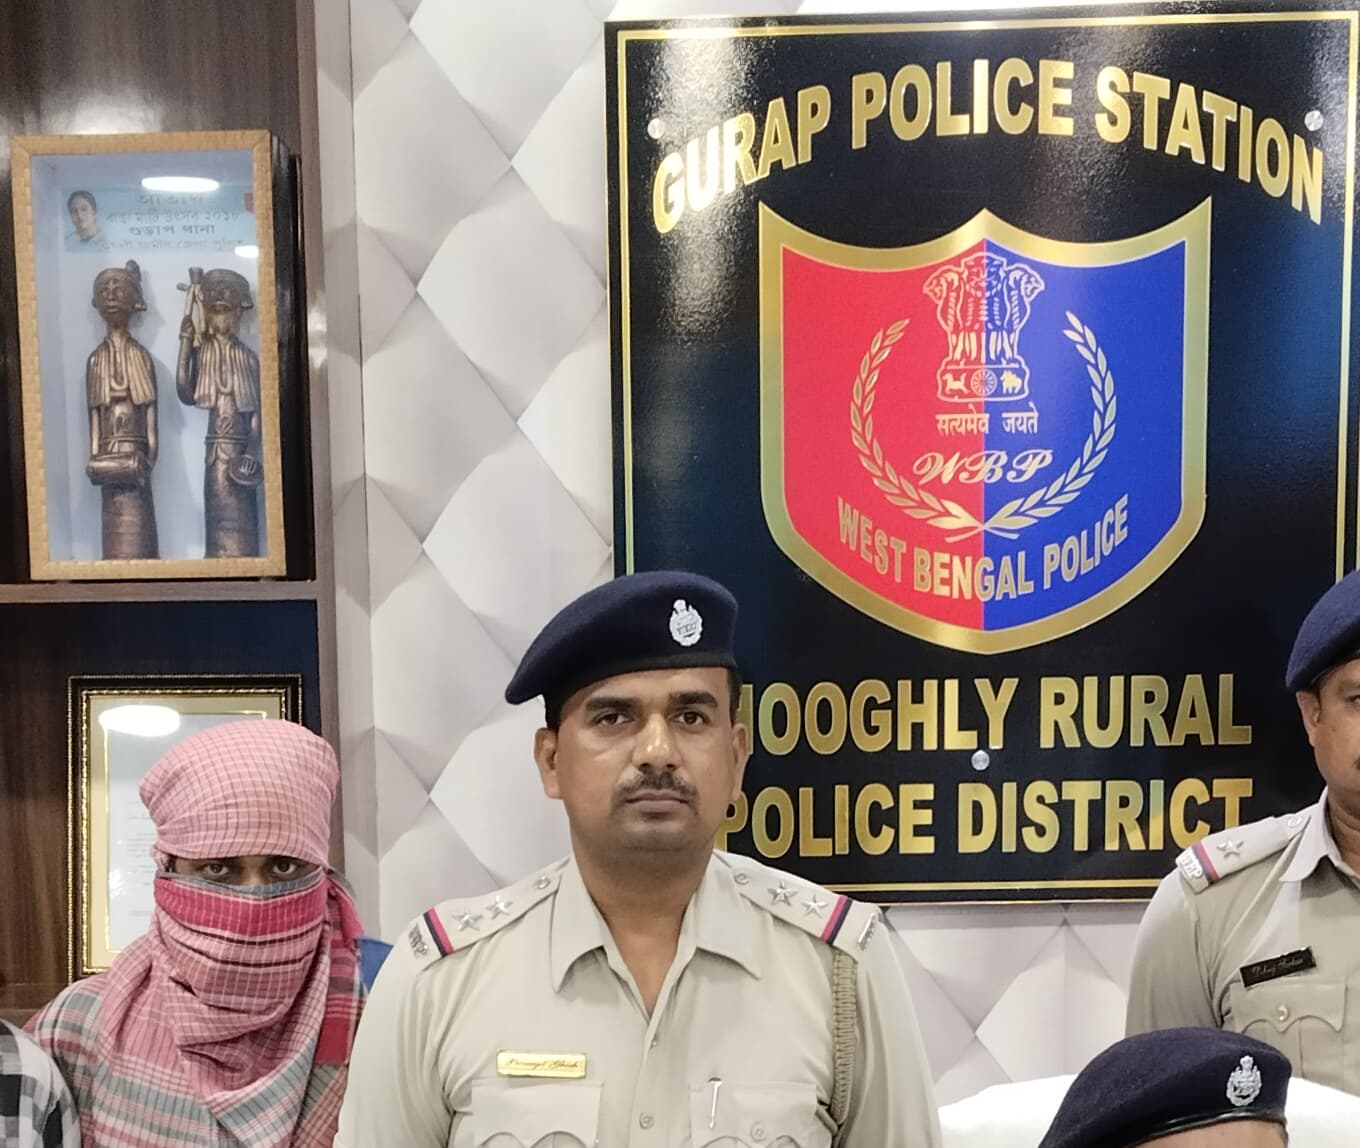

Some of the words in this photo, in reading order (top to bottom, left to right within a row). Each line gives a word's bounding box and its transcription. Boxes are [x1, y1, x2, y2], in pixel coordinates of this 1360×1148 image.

[652, 85, 832, 234] GURAP
[851, 58, 1075, 149] POLICE
[1094, 65, 1324, 226] STATION
[935, 402, 991, 436] सत्यमेव
[1001, 401, 1040, 435] जयते
[837, 495, 907, 584] WEST
[913, 546, 1035, 603] BENGAL
[1042, 493, 1130, 591] POLICE
[1039, 673, 1253, 750] RURAL
[957, 777, 1254, 856] DISTRICT
